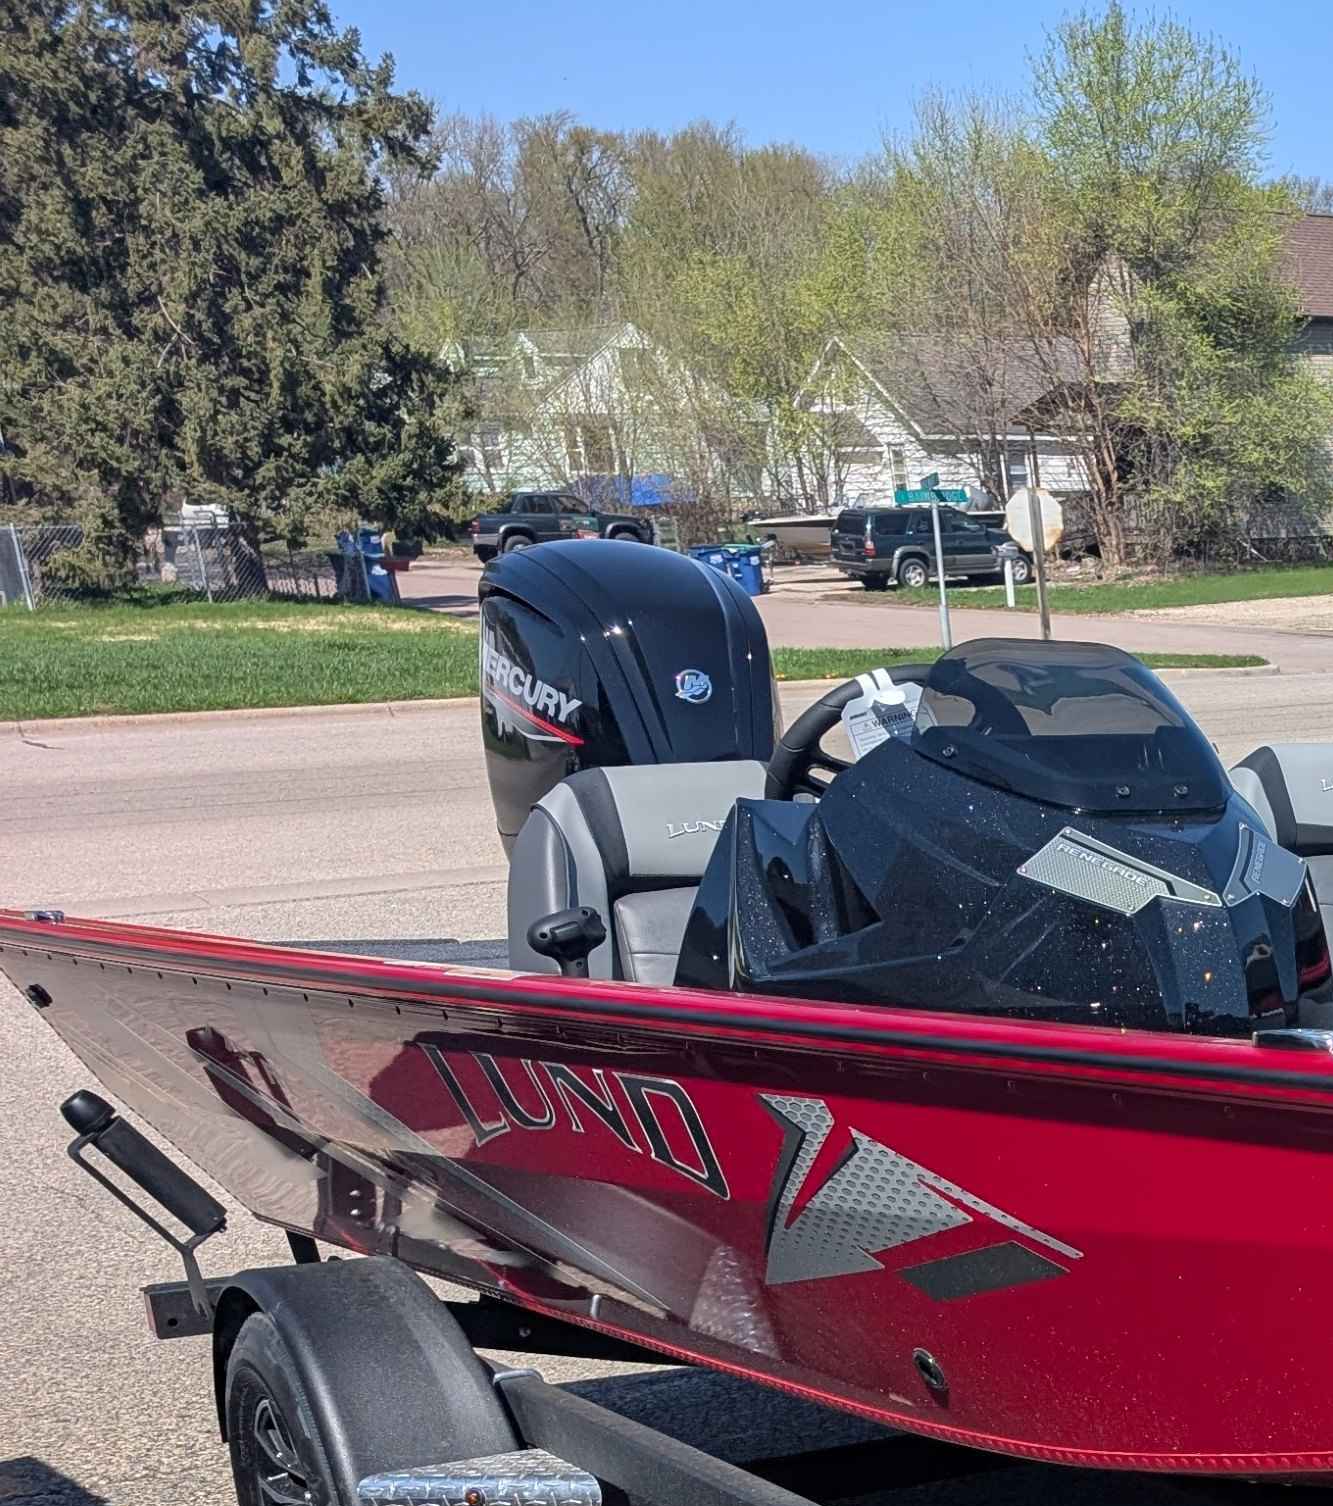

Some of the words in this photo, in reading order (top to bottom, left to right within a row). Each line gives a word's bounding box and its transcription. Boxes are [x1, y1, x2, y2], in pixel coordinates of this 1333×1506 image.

[665, 818, 726, 840] LUN
[1055, 842, 1148, 887] RENEGADE
[417, 1041, 732, 1201] LUND
